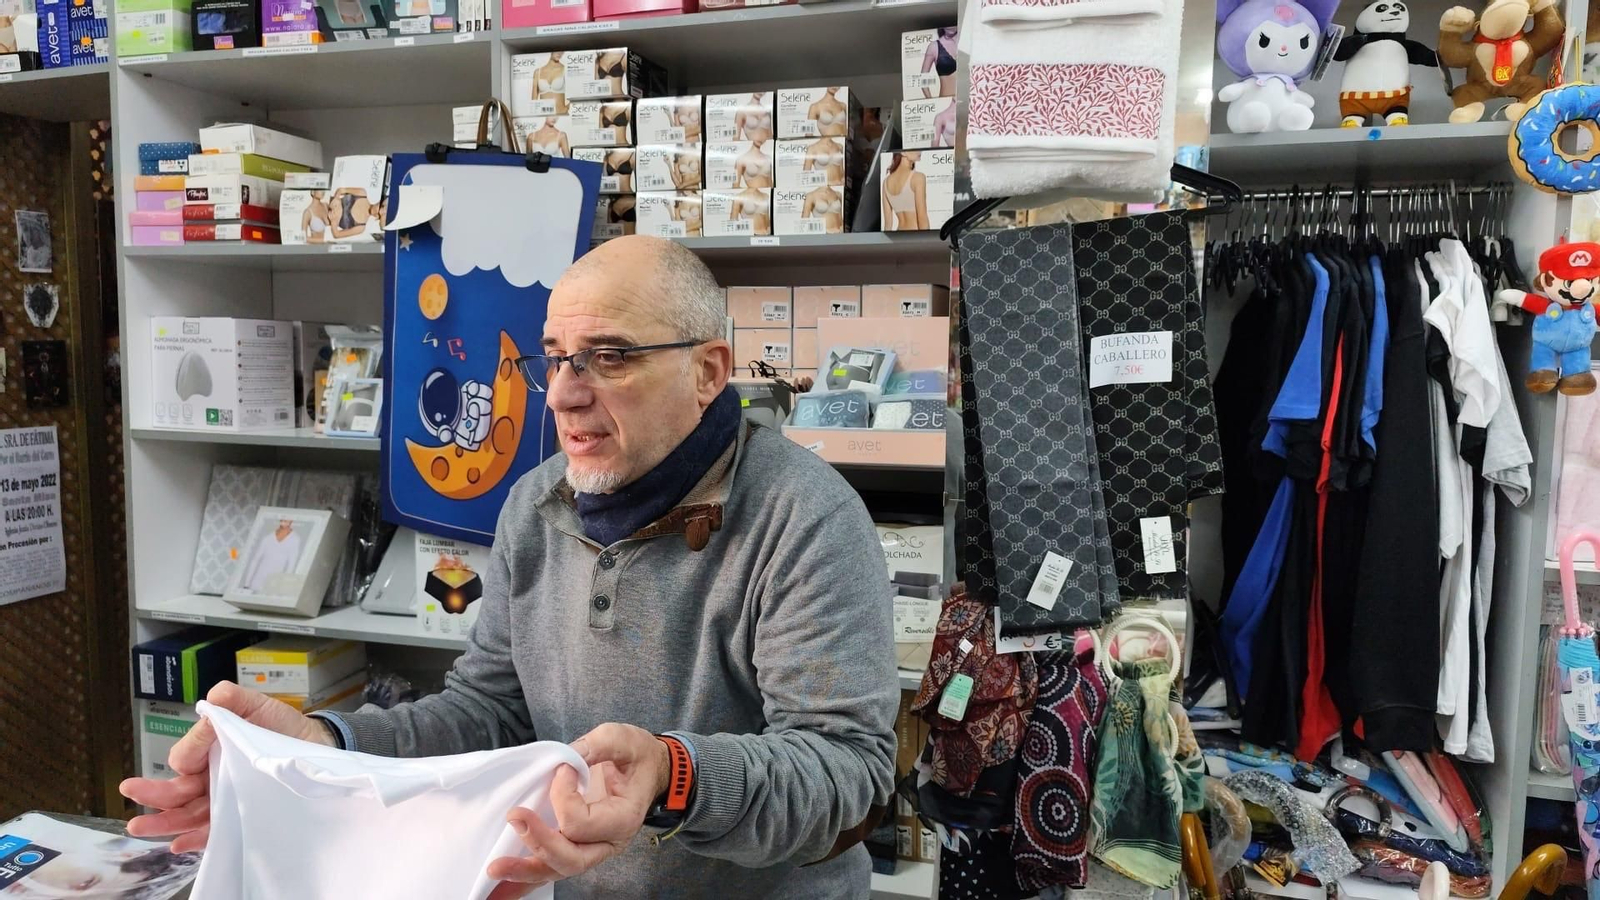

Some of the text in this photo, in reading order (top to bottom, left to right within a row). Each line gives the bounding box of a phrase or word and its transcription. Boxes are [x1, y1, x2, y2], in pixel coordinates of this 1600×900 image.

[70, 6, 93, 18] avet
[48, 26, 61, 64] avet
[905, 34, 933, 45] Selene
[512, 58, 536, 69] Selene
[567, 54, 594, 66] Selene
[781, 92, 811, 104] Selene
[571, 103, 599, 115] Selene
[905, 104, 936, 116] Selene
[1101, 334, 1159, 349] BUFANDA
[1094, 349, 1167, 365] CABALLERO
[1114, 365, 1144, 376] 7,50€
[801, 399, 860, 421] avet
[19, 433, 30, 447] DE
[847, 438, 882, 453] avet
[1, 473, 57, 492] 13 de mayo 2022
[5, 510, 11, 523] A
[12, 507, 26, 522] LAS
[8, 537, 38, 550] Procesión
[432, 539, 455, 547] LUMBAR
[431, 547, 451, 555] EFECTO
